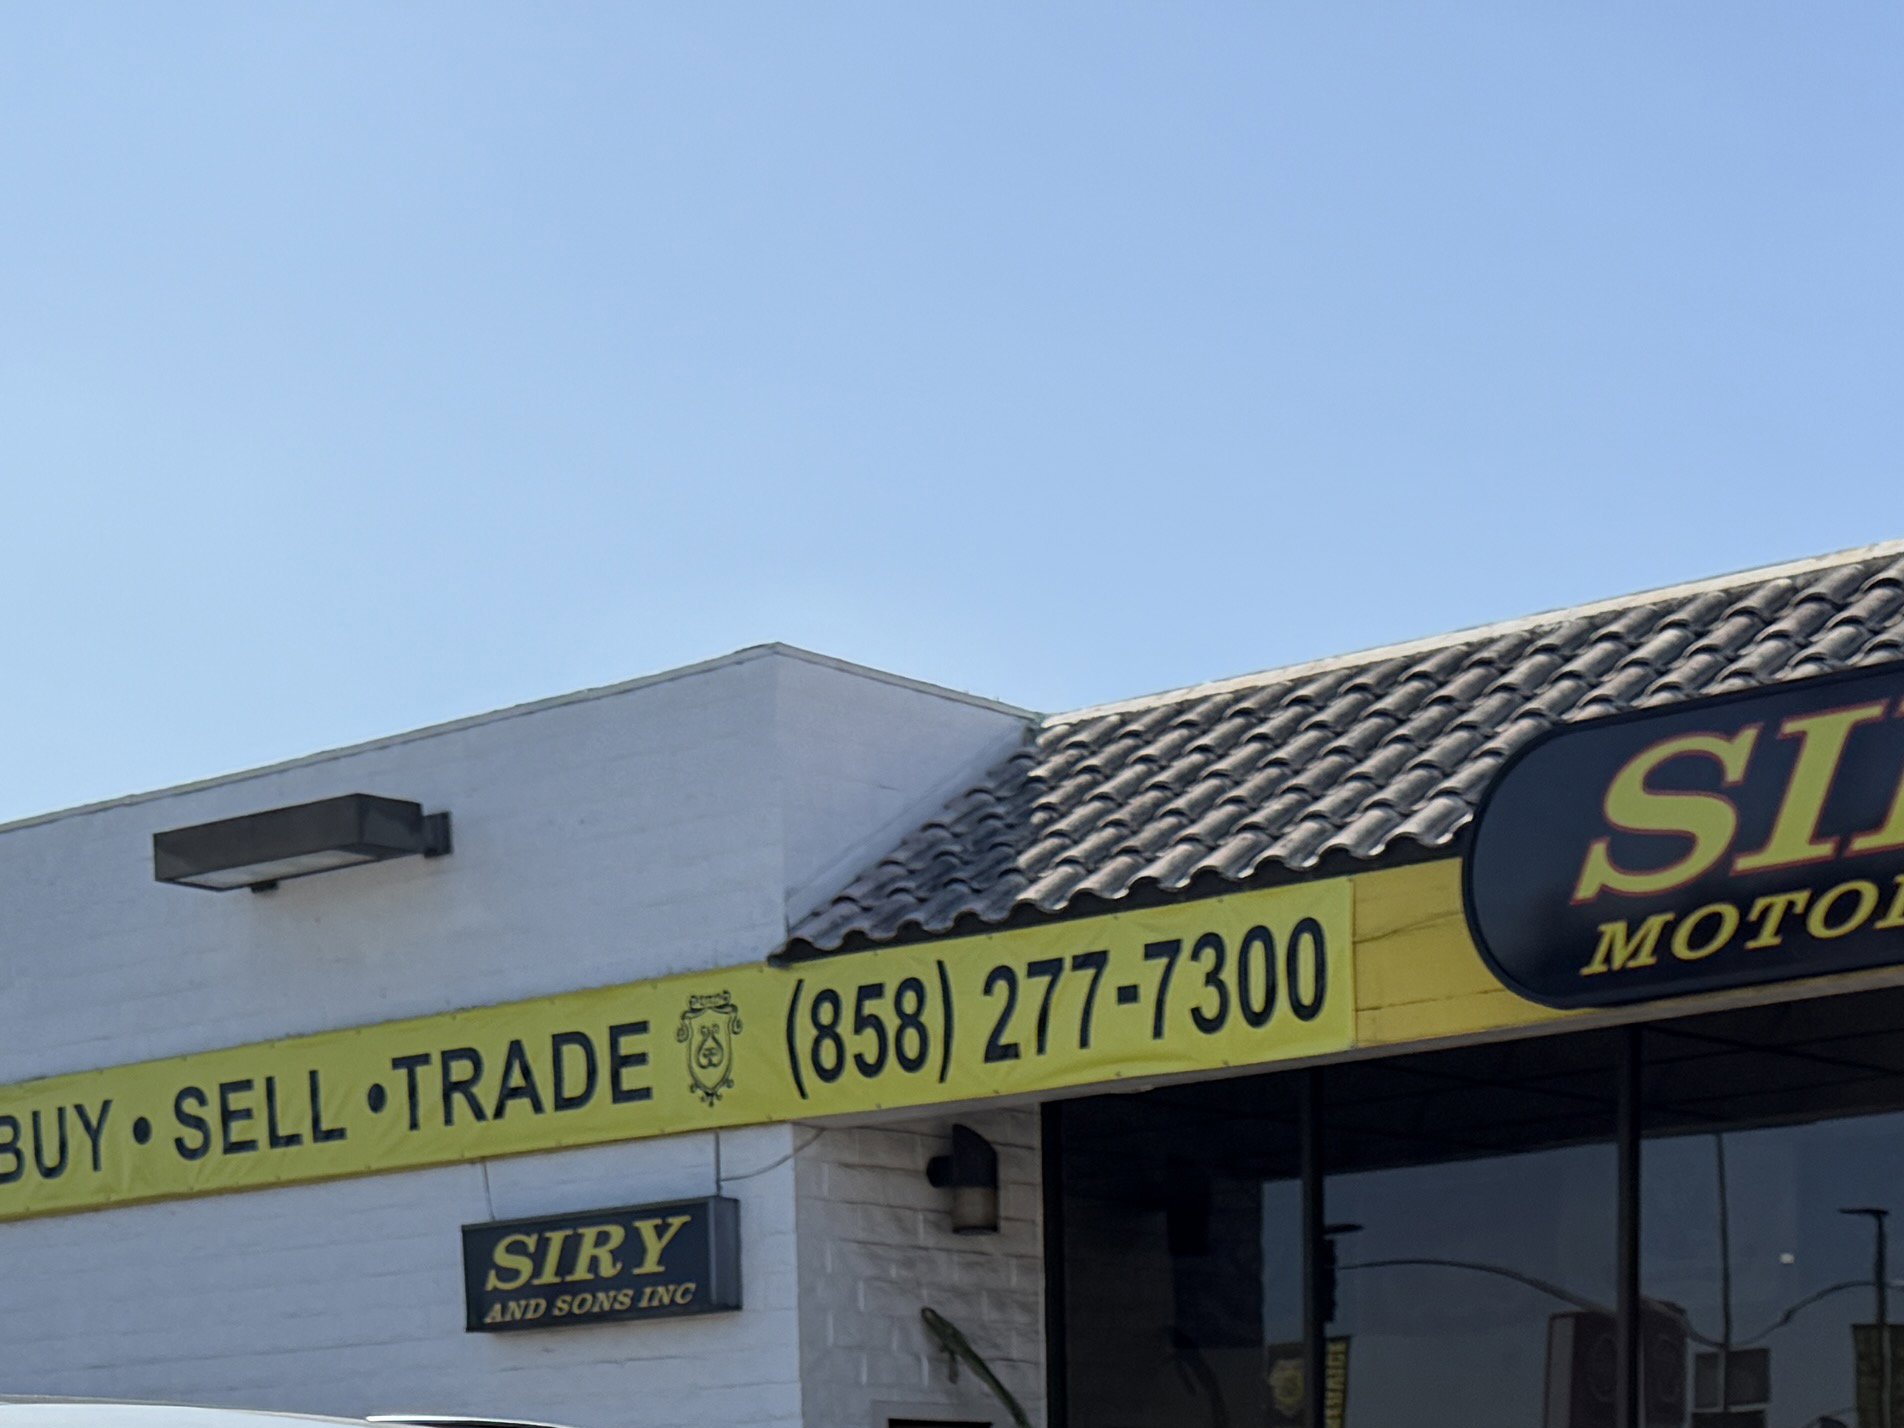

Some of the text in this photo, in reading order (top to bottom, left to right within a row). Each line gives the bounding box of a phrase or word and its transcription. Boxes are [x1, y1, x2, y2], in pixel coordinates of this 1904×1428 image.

[786, 917, 1327, 1099] (858) 277-7300
[175, 1069, 348, 1160] SELL
[392, 1020, 655, 1130] TRADE
[484, 1281, 696, 1324] AND SONS INC
[485, 1214, 692, 1292] SIRY
